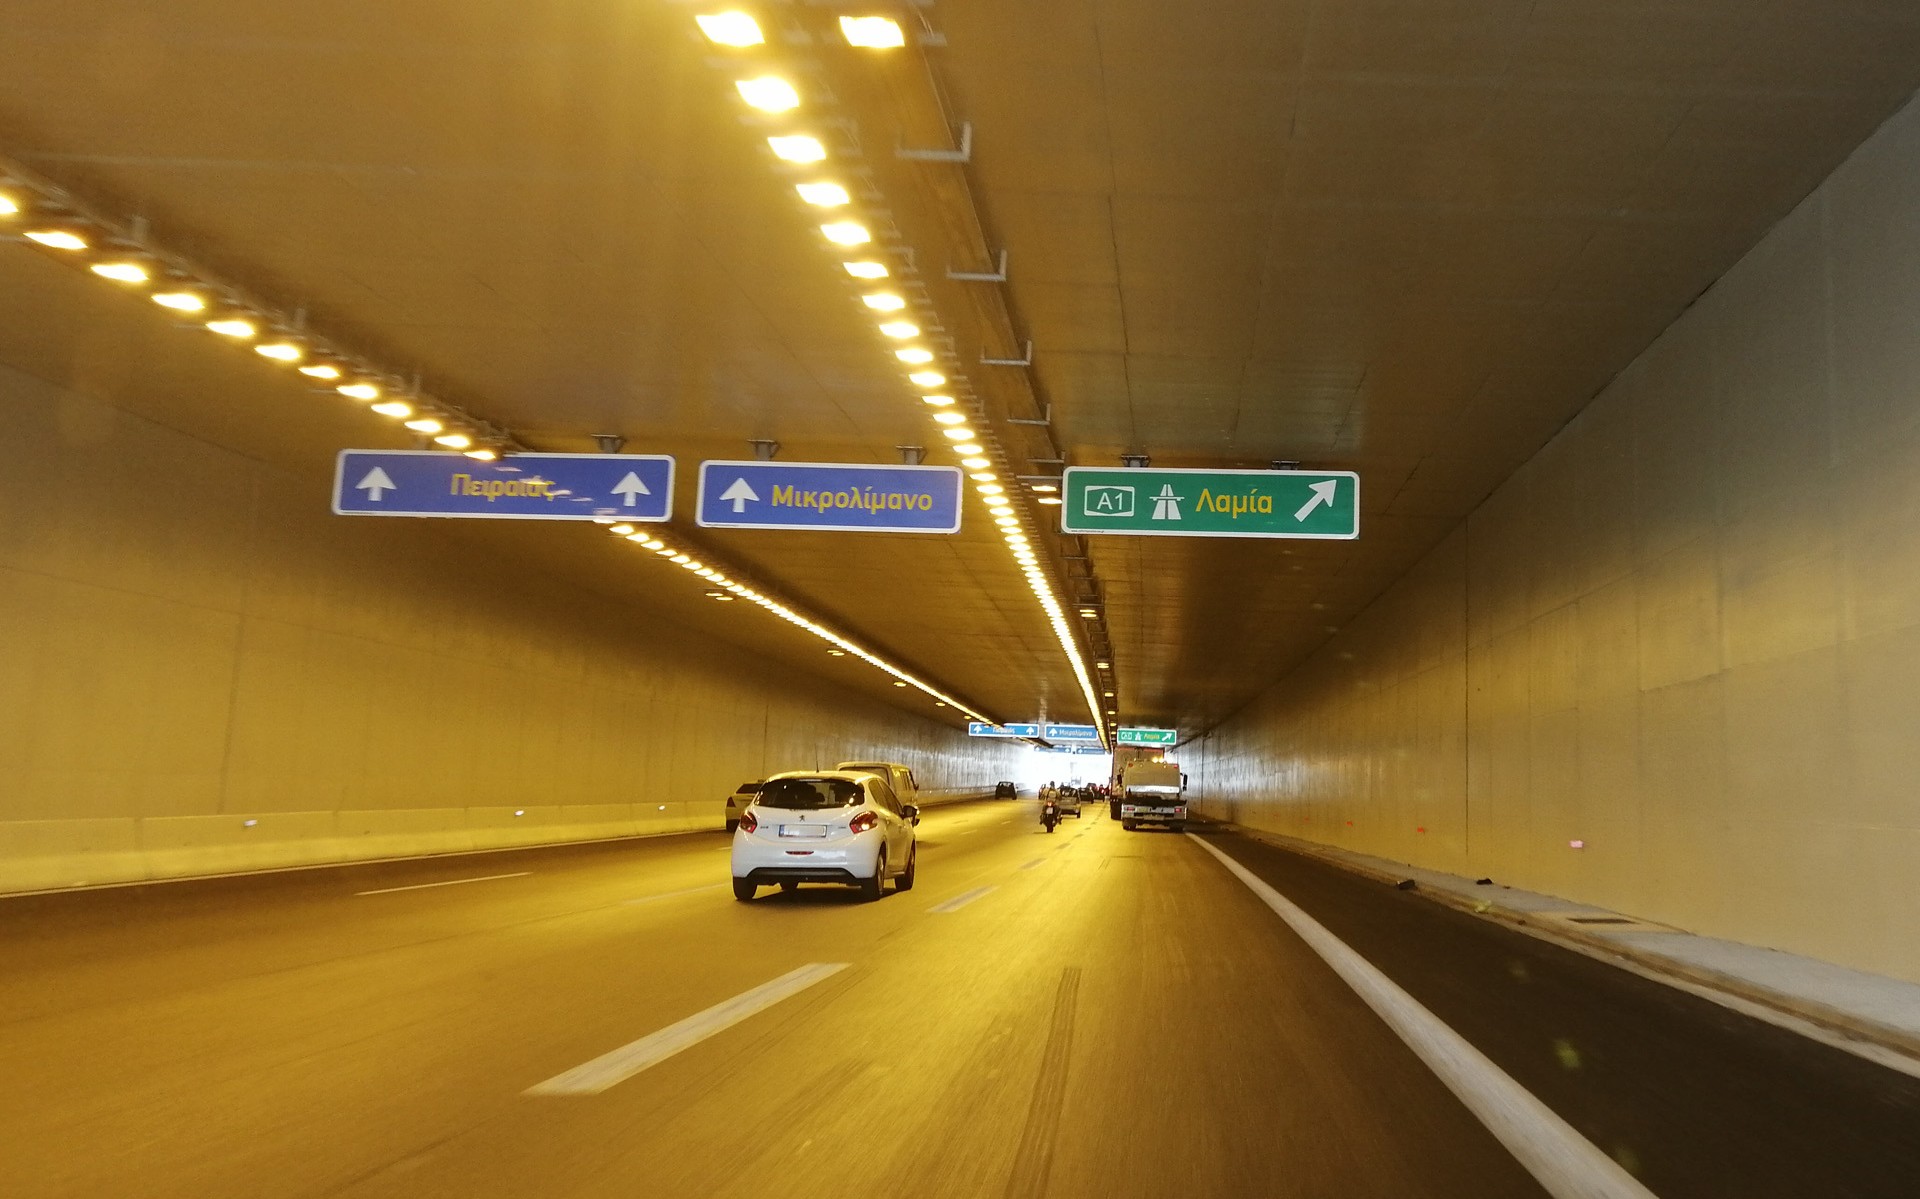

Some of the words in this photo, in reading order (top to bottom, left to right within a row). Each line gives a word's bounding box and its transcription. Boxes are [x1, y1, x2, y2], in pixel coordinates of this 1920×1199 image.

[771, 484, 933, 515] Μικρολίμανο
[1096, 491, 1123, 510] A1
[1195, 488, 1273, 519] Λαμία
